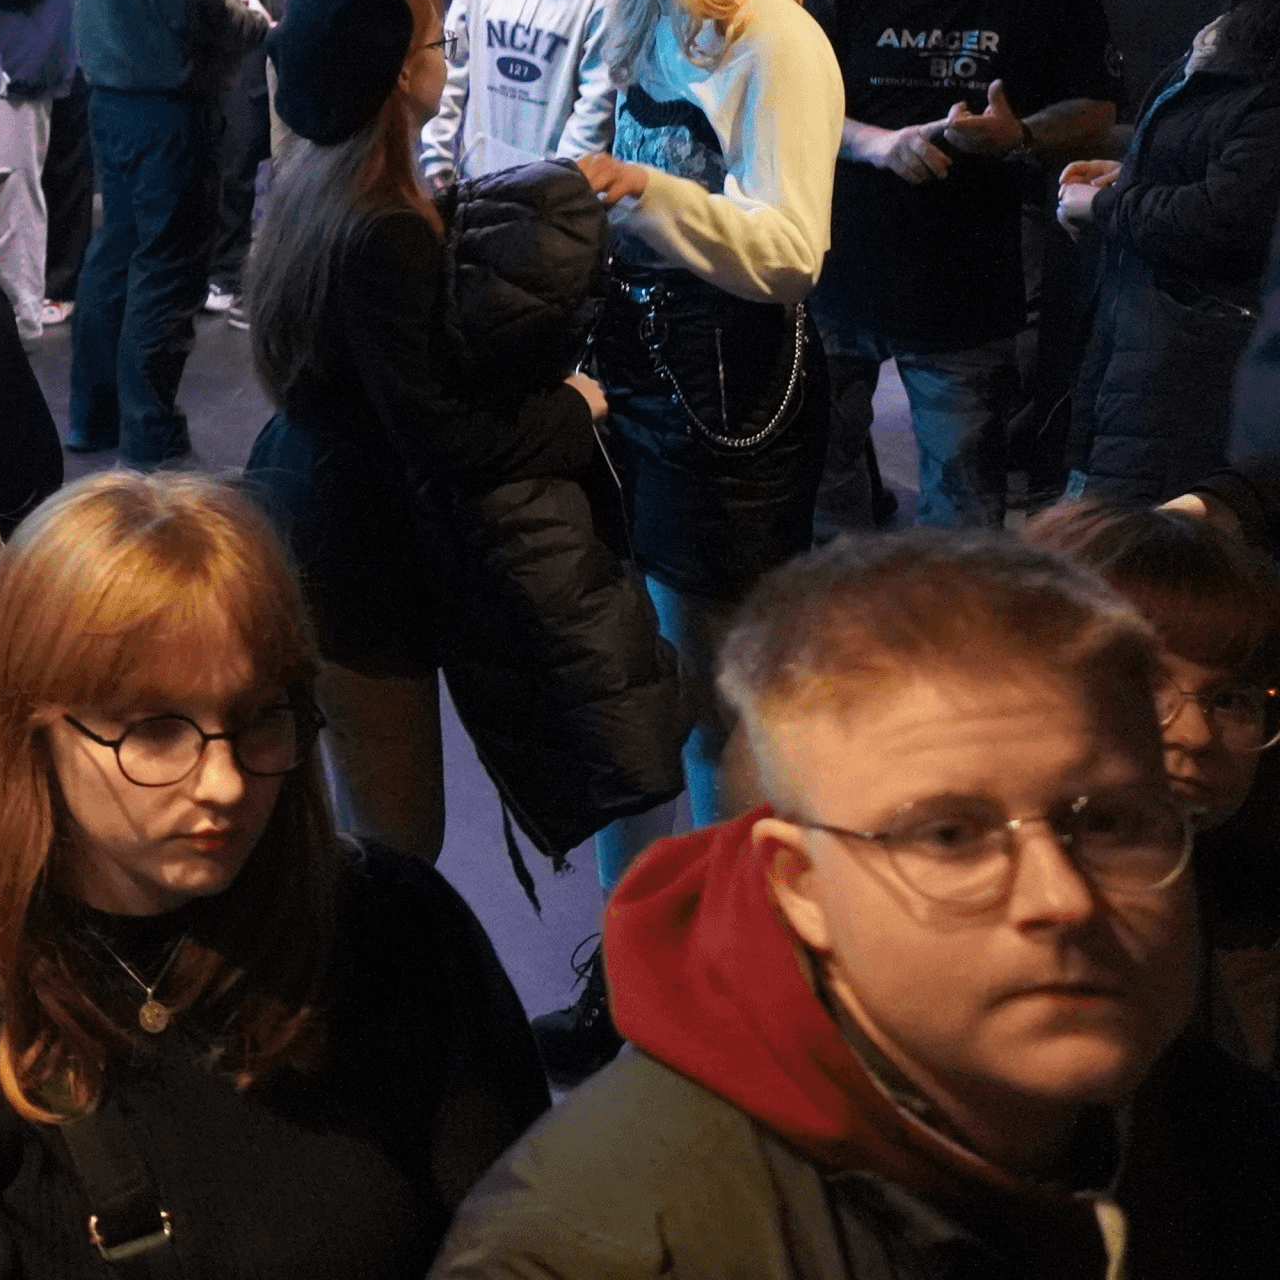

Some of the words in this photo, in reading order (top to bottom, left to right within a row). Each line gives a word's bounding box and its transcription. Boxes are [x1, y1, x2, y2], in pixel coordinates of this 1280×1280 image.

[486, 19, 569, 64] NCIT
[876, 27, 1000, 54] AMAGER
[509, 62, 529, 77] 127
[930, 57, 977, 78] BIO
